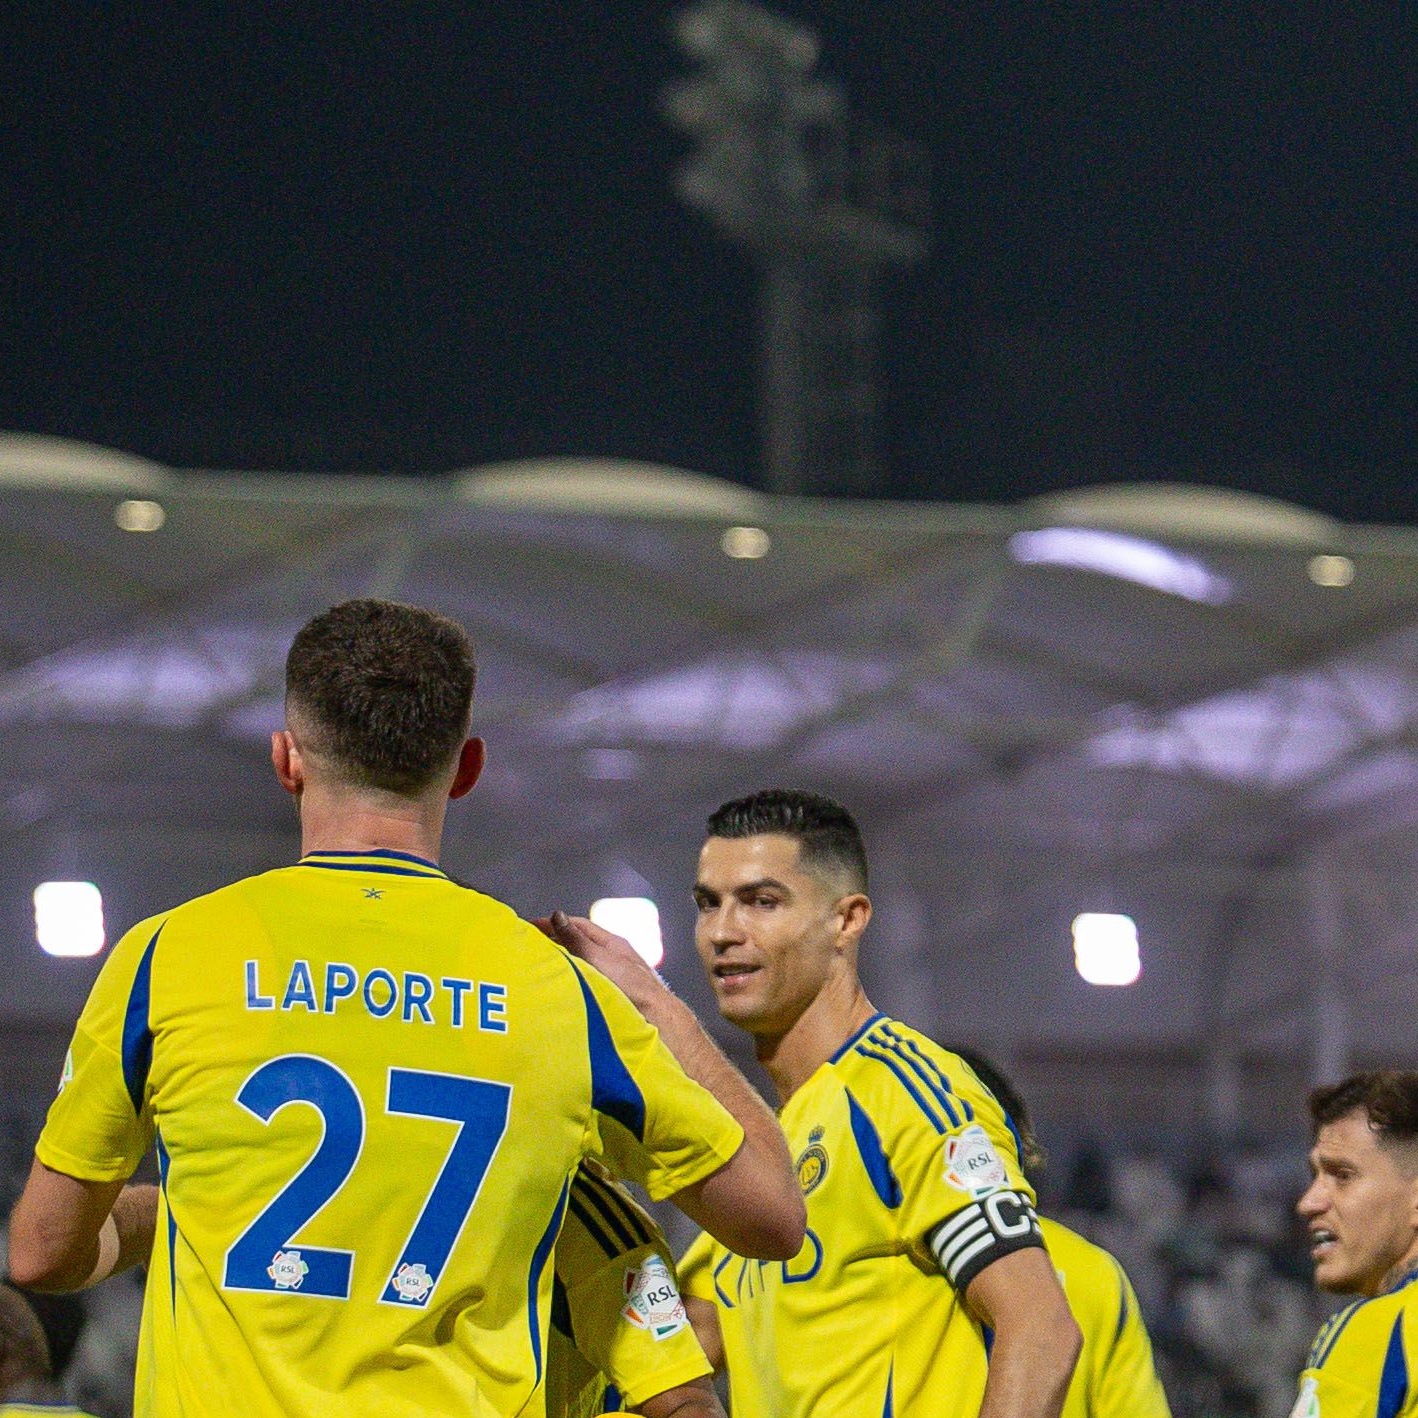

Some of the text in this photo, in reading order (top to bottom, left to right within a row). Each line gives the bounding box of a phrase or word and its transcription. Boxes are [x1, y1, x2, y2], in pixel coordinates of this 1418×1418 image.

[243, 959, 509, 1034] LAPORTE
[221, 1053, 514, 1310] 27
[967, 1151, 994, 1171] RSL
[984, 1190, 1031, 1239] C
[646, 1284, 676, 1307] RSL
